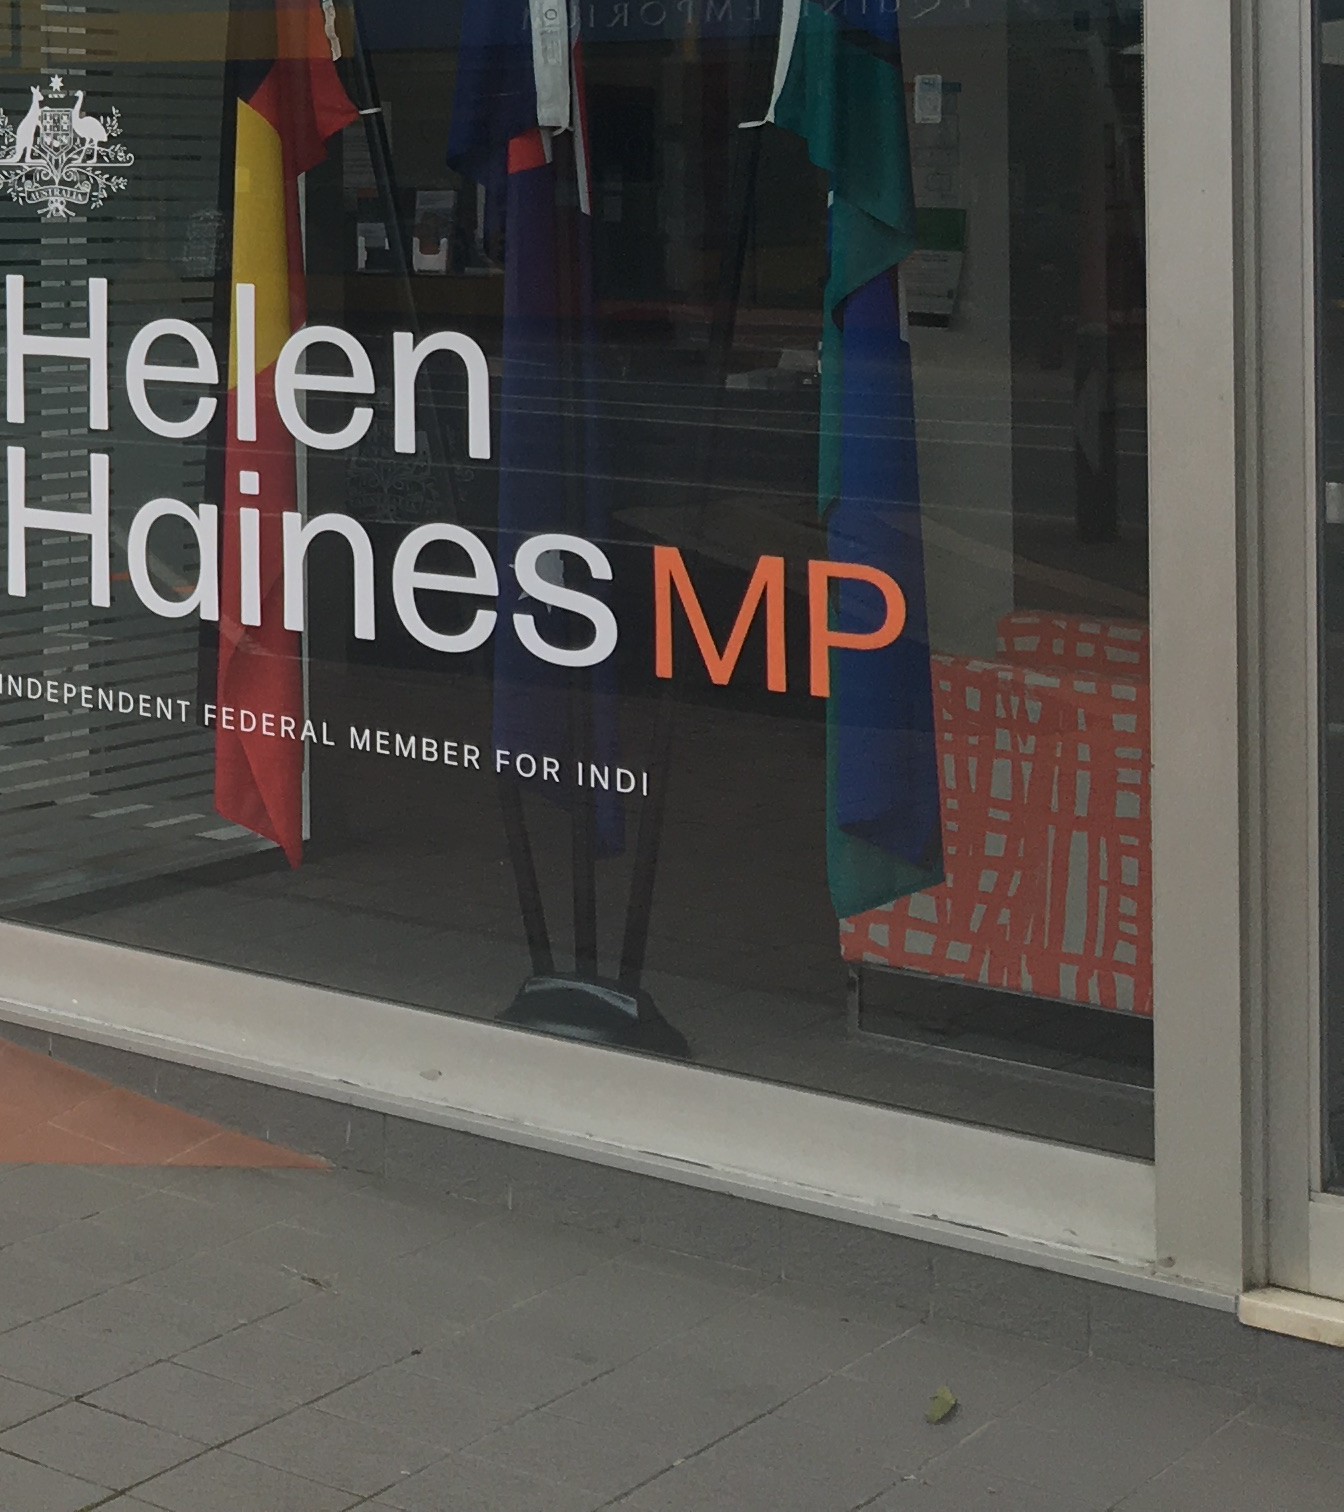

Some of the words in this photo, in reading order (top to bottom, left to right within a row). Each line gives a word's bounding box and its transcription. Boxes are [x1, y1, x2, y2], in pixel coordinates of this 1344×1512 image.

[5, 274, 492, 459] Helen
[6, 445, 619, 668] Haines
[652, 545, 907, 699] MP
[202, 703, 336, 747] FEDERAL
[348, 725, 482, 771] MEMBER
[494, 749, 561, 784] FOR
[576, 761, 650, 797] INDI
